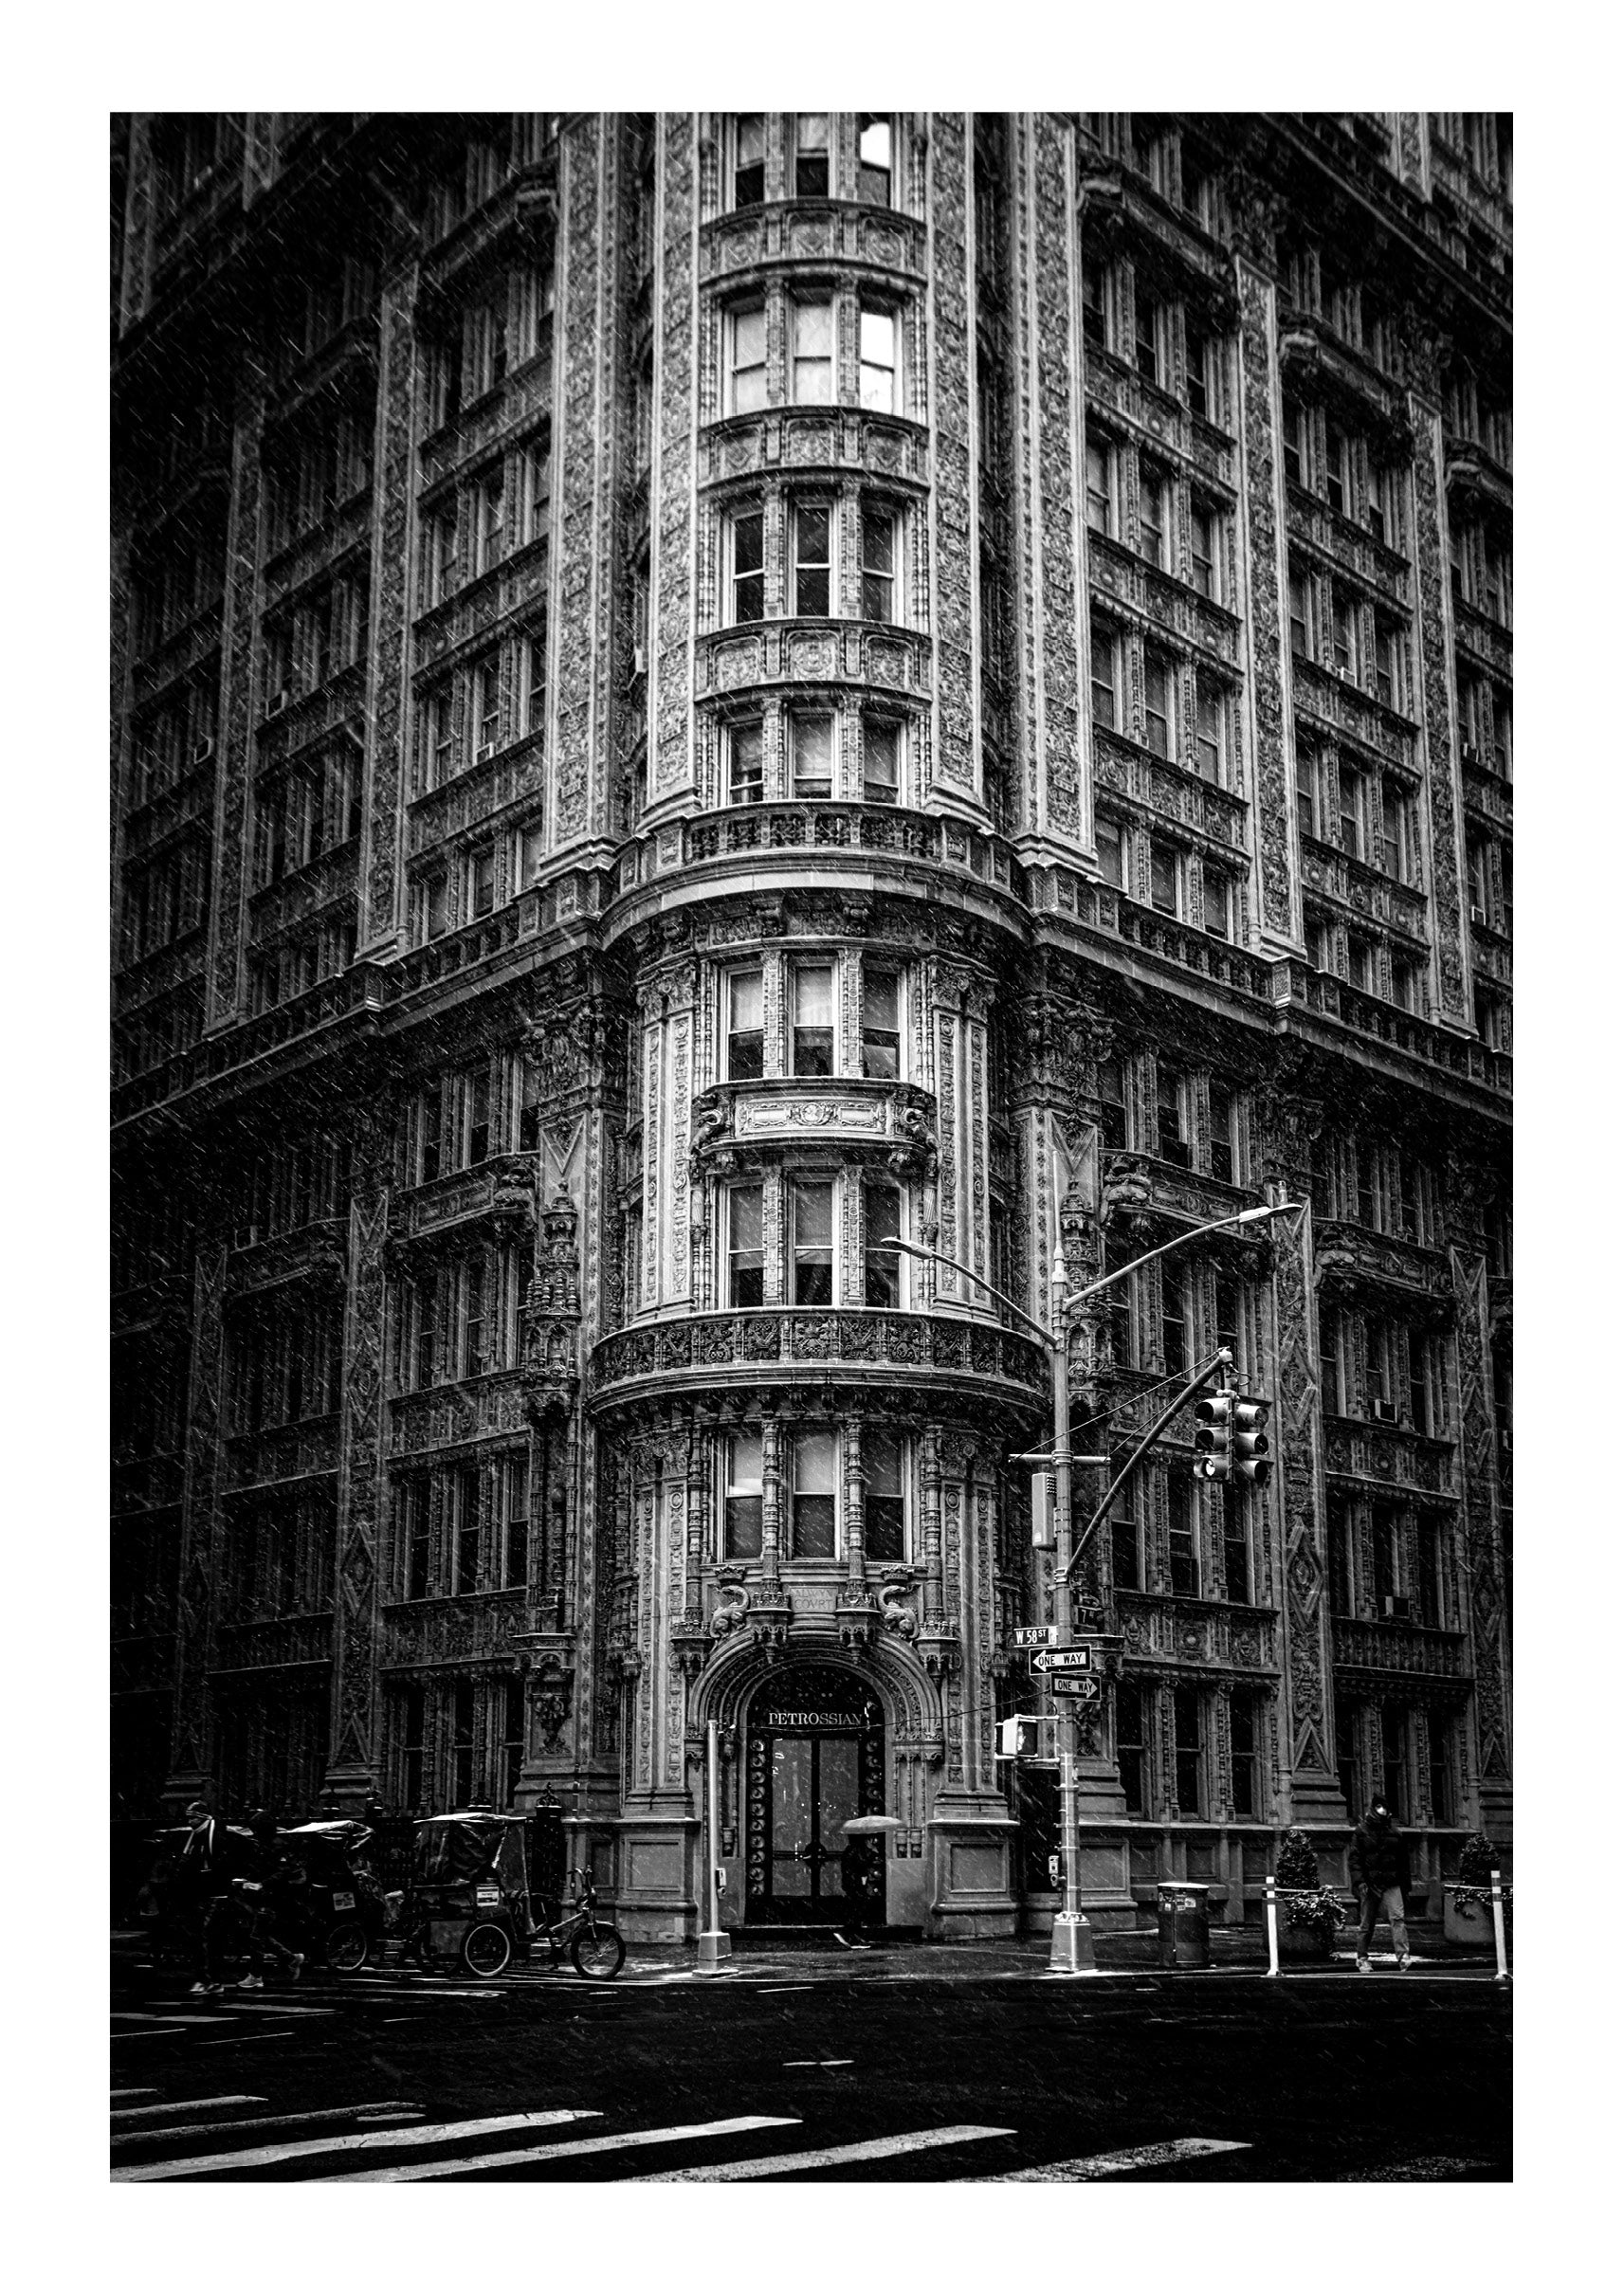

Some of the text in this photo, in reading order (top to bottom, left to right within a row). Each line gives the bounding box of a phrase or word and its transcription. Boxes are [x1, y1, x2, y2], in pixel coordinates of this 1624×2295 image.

[1015, 1630, 1024, 1644] W
[1039, 1653, 1082, 1666] ONE WAY
[1057, 1680, 1093, 1692] ONE WAY
[768, 1712, 862, 1725] PETROSSIAN
